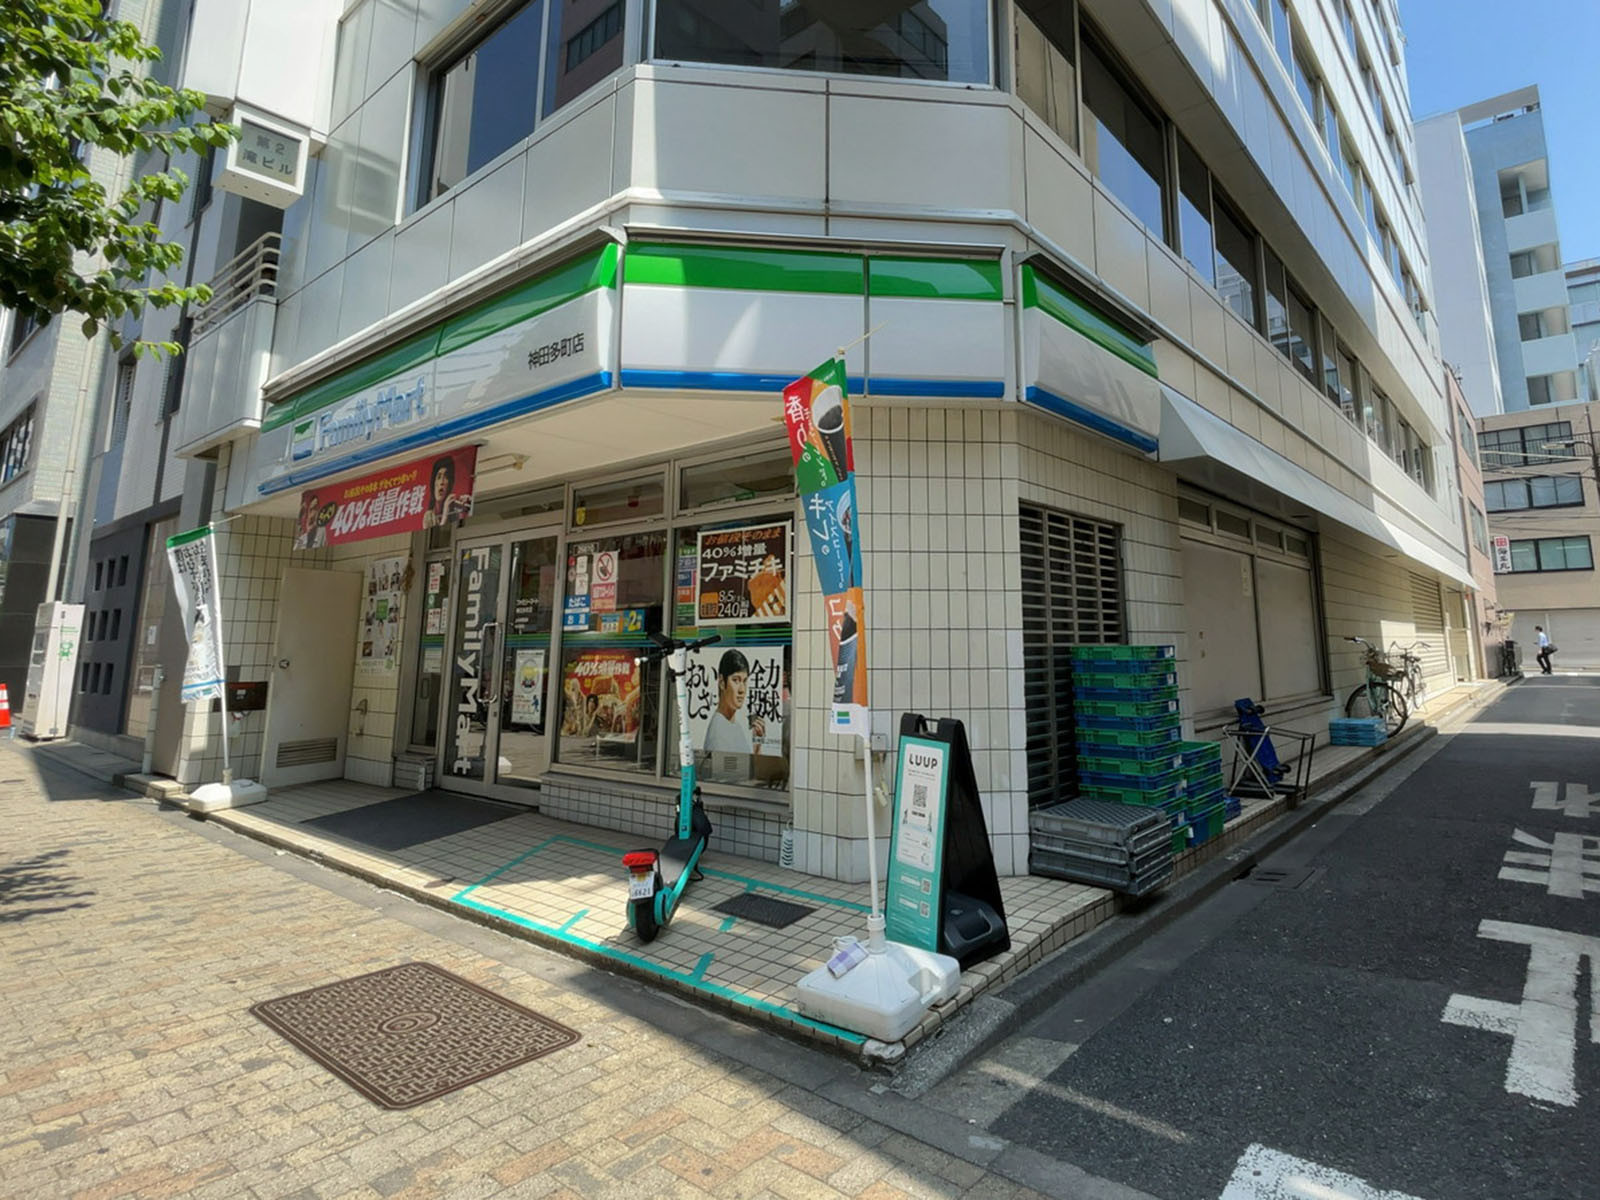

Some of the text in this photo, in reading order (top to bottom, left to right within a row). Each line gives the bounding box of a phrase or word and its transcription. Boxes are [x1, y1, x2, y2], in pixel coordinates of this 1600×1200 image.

[527, 332, 585, 371] 神田多町店
[318, 375, 427, 450] FamilyMart
[330, 484, 428, 537] 40%増量作戦
[702, 542, 768, 559] 40%増量
[704, 527, 782, 546] お値段そのまま
[702, 558, 783, 582] ファミチキ
[686, 659, 718, 688] おい
[750, 658, 781, 689] 全力
[908, 753, 938, 769] LUUP
